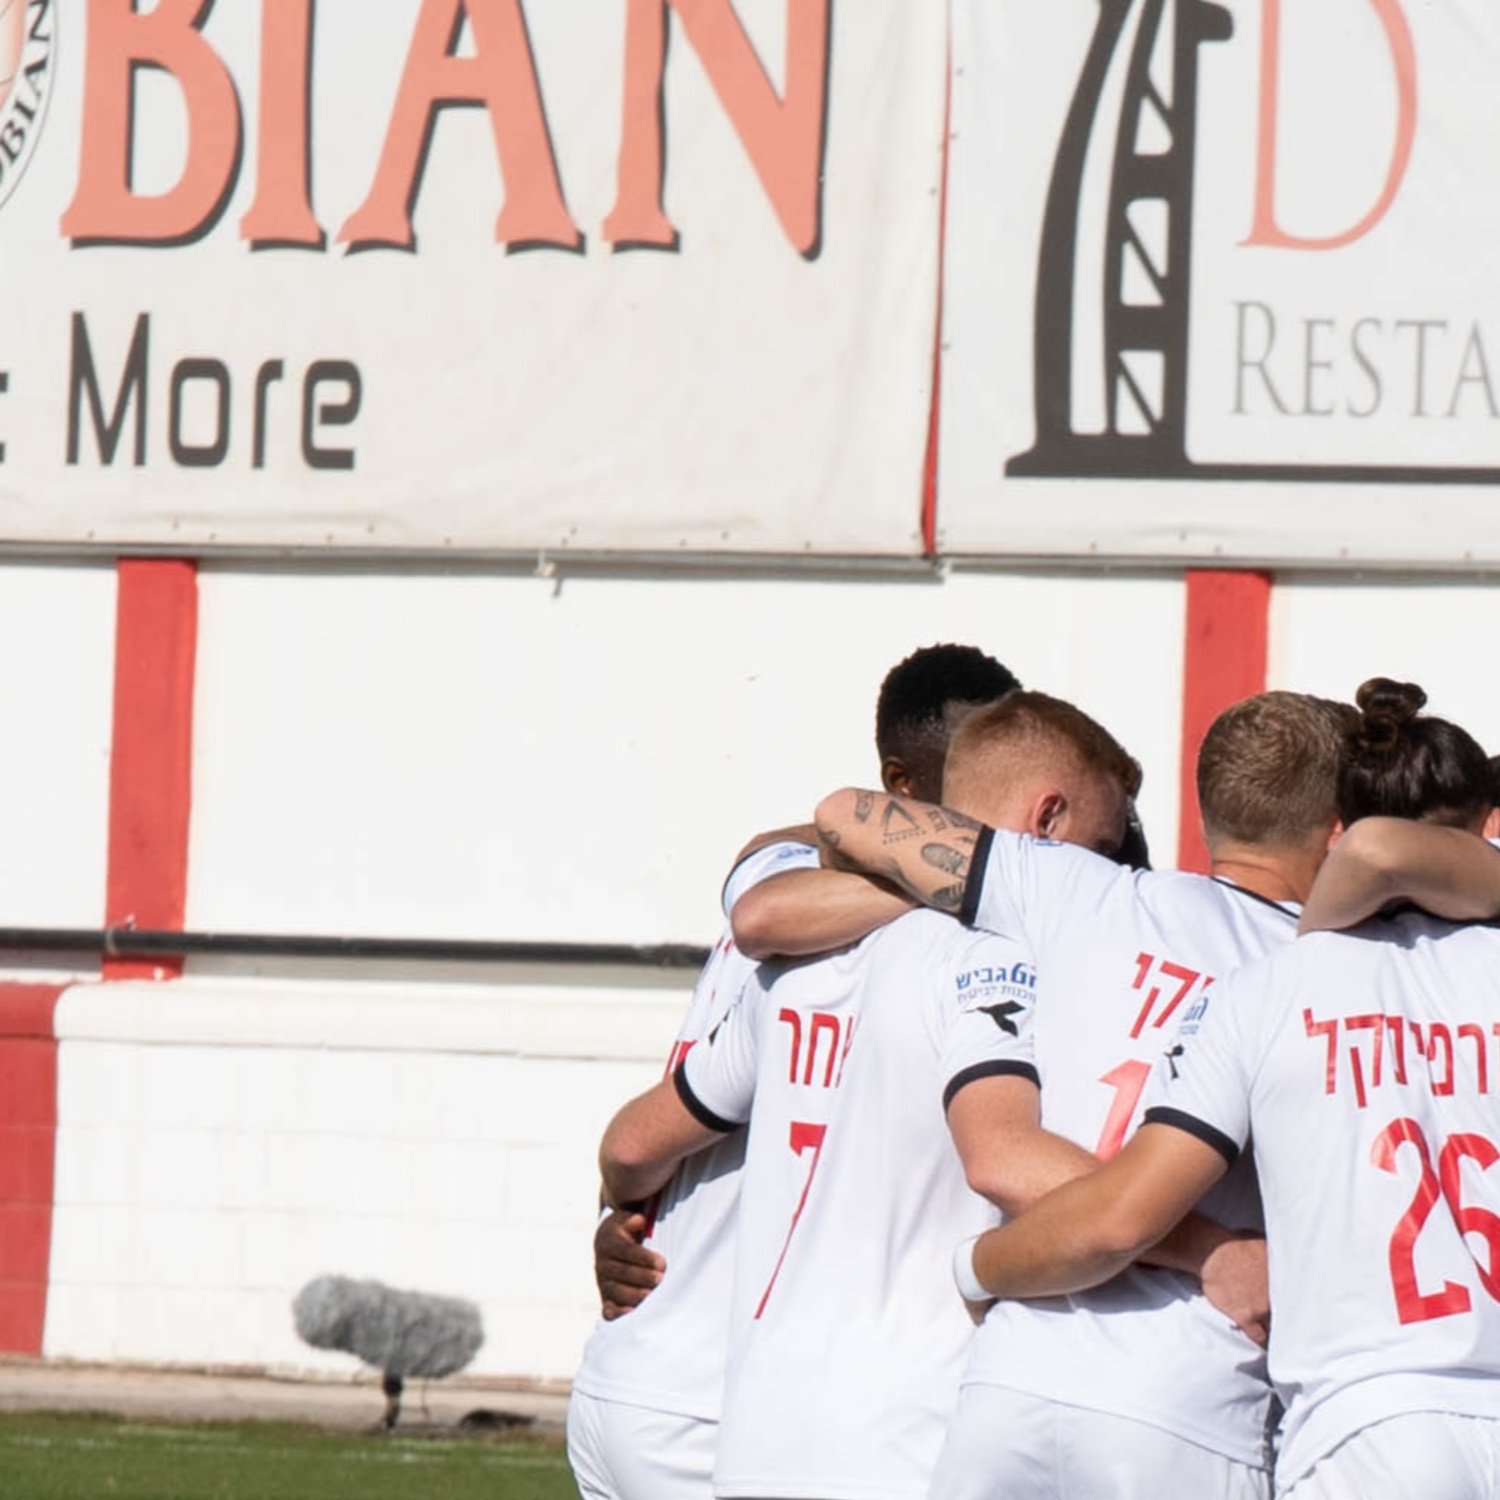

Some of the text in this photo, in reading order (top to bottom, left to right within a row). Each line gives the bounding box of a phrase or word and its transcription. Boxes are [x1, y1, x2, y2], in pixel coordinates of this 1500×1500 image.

[0, 0, 51, 188] BIAN
[65, 310, 364, 471] More
[755, 1121, 827, 1320] 7
